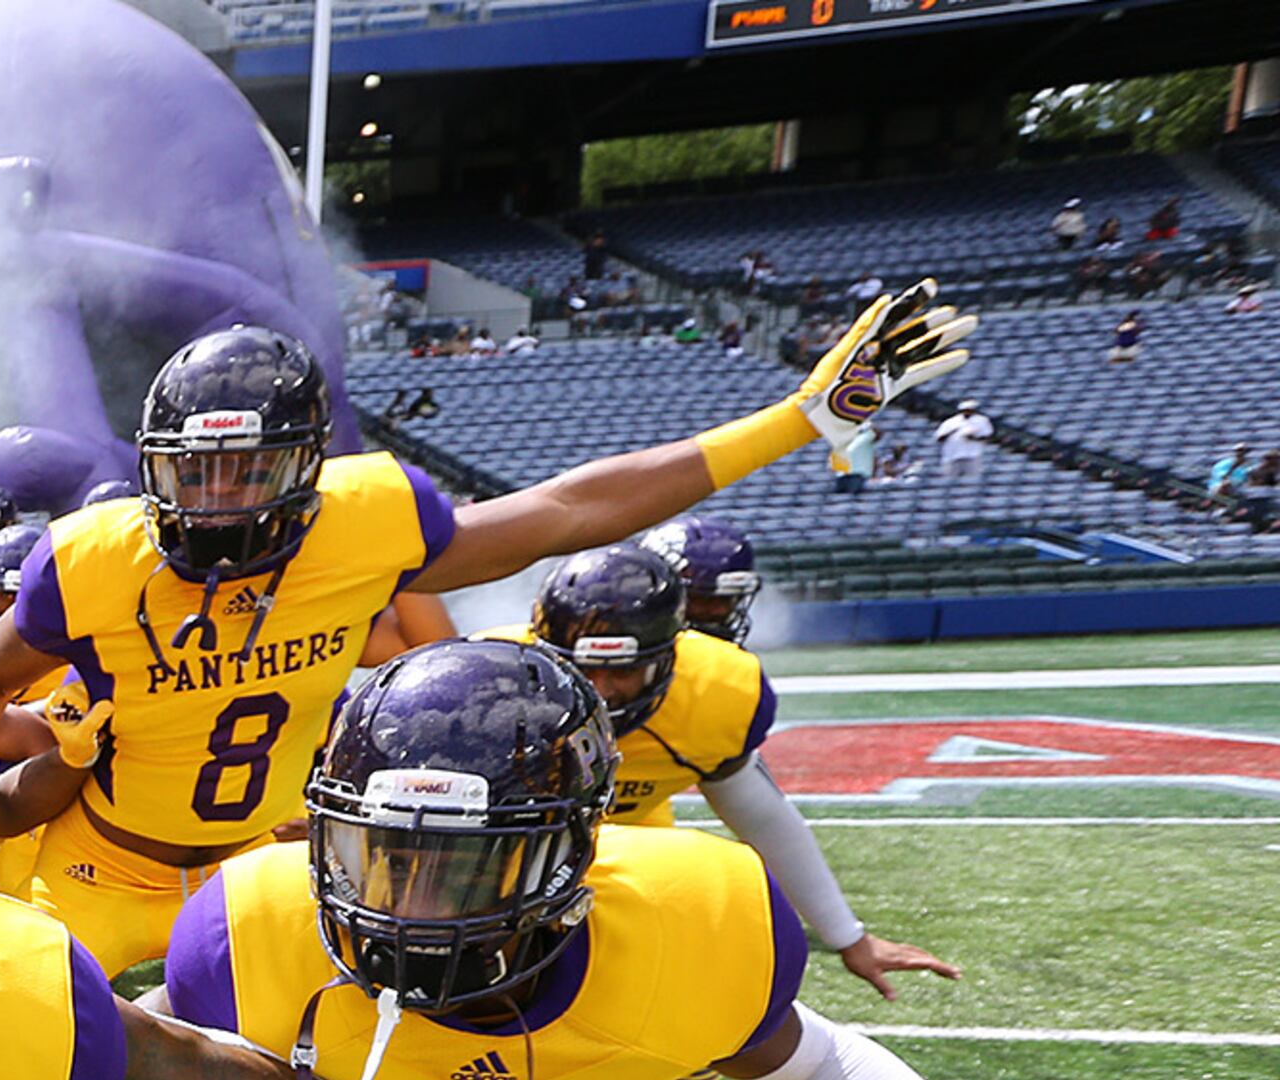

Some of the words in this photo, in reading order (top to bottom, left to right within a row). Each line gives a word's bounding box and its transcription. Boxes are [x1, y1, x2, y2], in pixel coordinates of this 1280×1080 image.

[202, 416, 244, 429] Riddell
[147, 626, 350, 694] PANTHERS
[191, 691, 290, 822] 8
